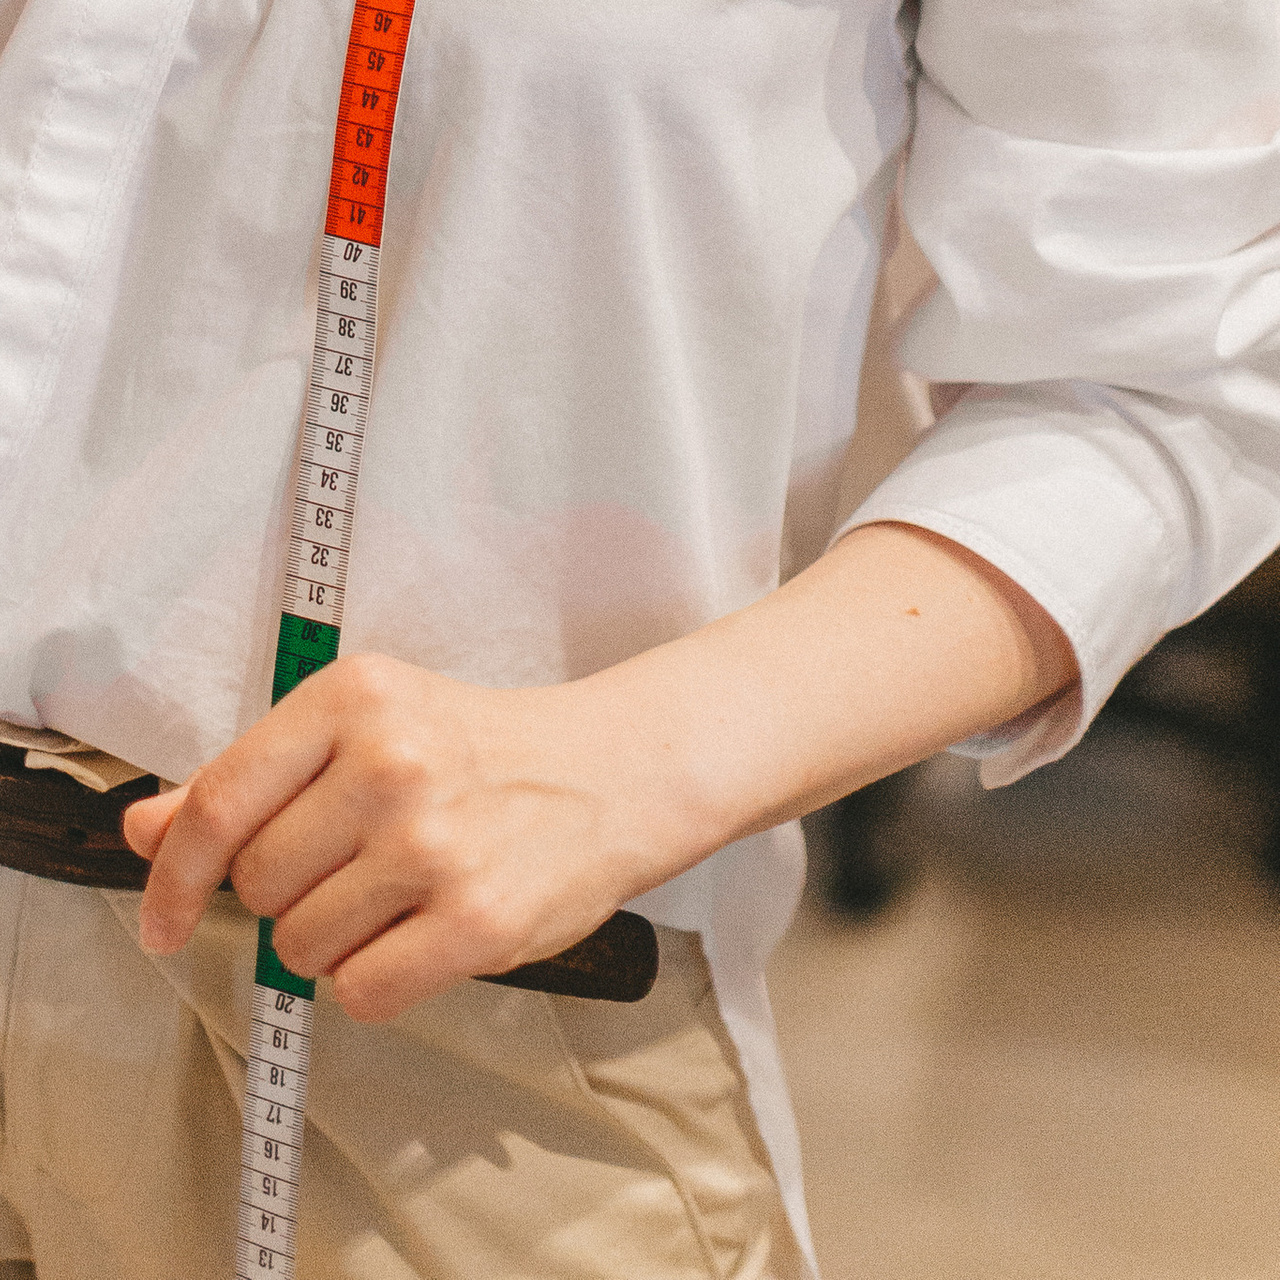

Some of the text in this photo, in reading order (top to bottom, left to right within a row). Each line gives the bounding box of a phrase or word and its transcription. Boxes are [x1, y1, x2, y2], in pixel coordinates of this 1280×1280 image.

[373, 12, 392, 33] 46
[367, 50, 386, 72] 45
[361, 88, 380, 110] 44
[356, 127, 374, 148] 43
[352, 165, 369, 186] 42
[349, 204, 366, 225] 41
[343, 242, 363, 263] 40
[340, 280, 358, 301] 39
[338, 317, 356, 339] 38
[334, 355, 353, 376] 37
[330, 393, 350, 414] 36
[325, 431, 344, 453] 35
[320, 469, 339, 491] 34
[315, 507, 334, 529] 33
[310, 544, 329, 567] 32
[308, 583, 325, 606] 31
[300, 621, 322, 643] 30
[274, 992, 296, 1014] 20
[272, 1029, 289, 1051] 19
[270, 1066, 286, 1088] 18
[266, 1104, 282, 1125] 17
[263, 1140, 280, 1162] 16
[262, 1176, 279, 1198] 15
[260, 1212, 276, 1234] 14
[258, 1249, 274, 1270] 13
